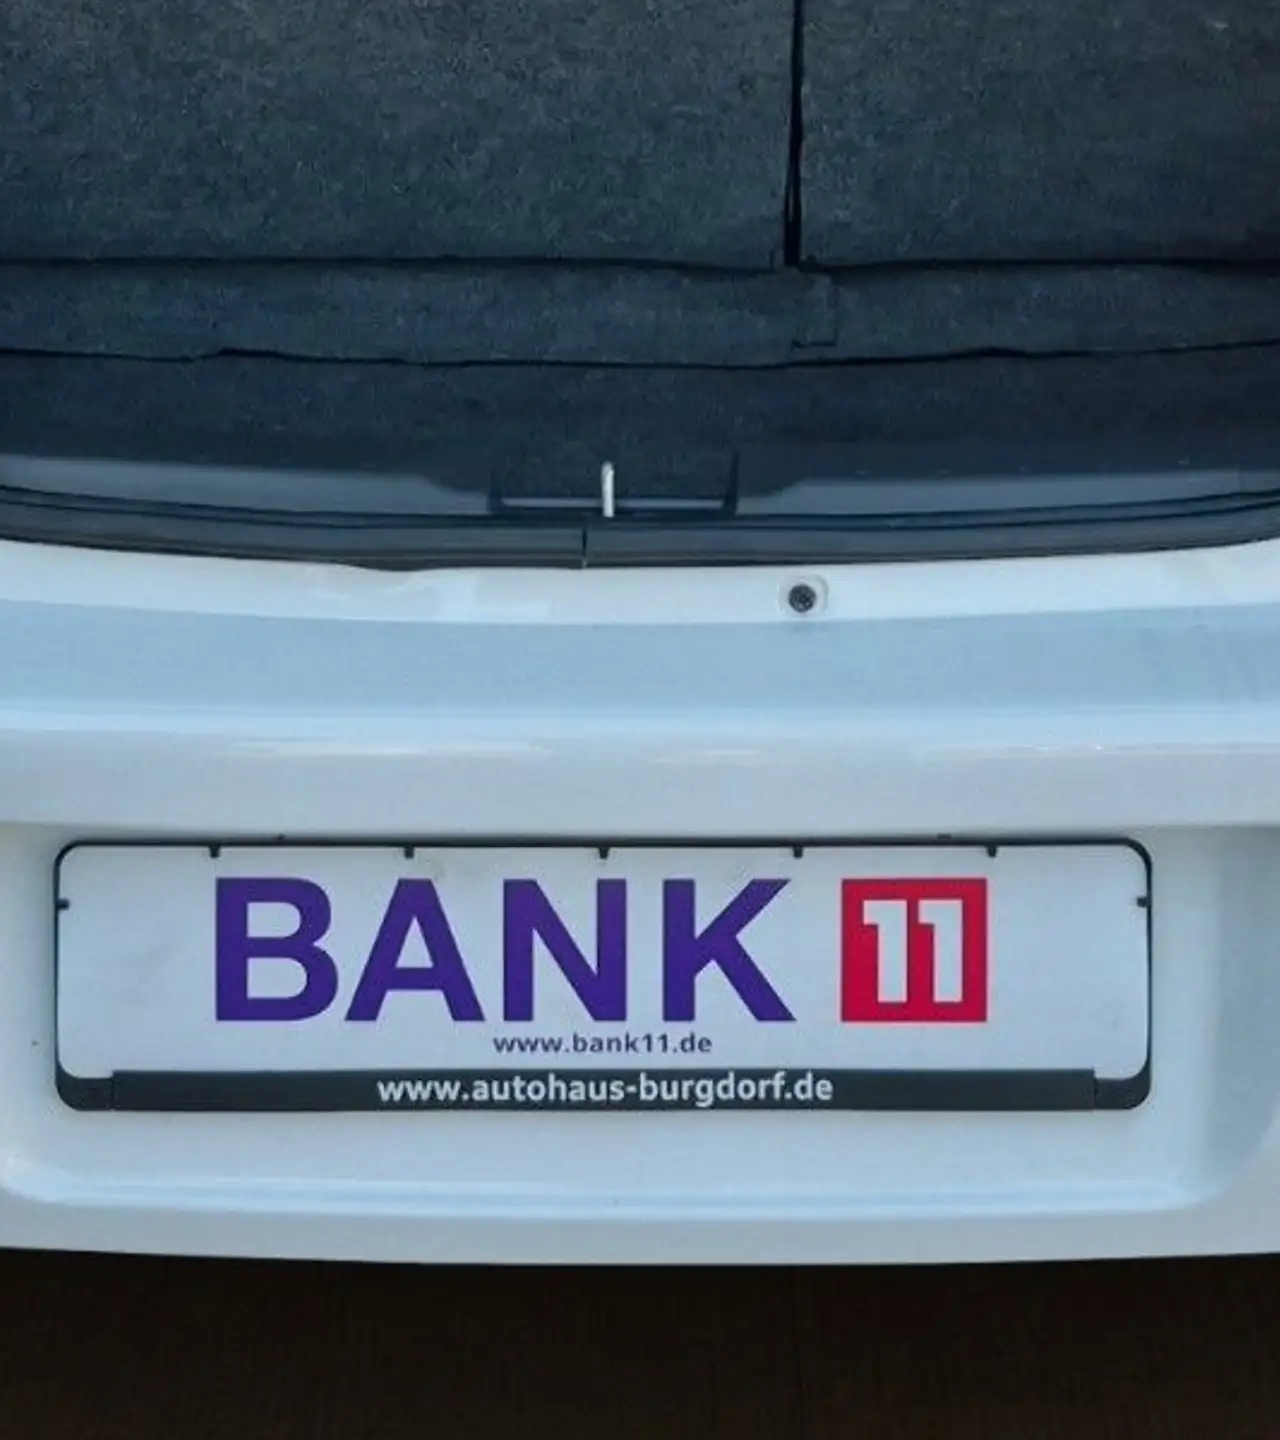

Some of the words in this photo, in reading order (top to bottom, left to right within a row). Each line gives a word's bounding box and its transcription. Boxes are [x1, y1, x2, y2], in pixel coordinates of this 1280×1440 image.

[216, 878, 795, 1023] BANK
[861, 897, 965, 1005] 11
[493, 1032, 713, 1054] www.bank11.de
[377, 1071, 834, 1107] www.autohaus-burgdorf.de
